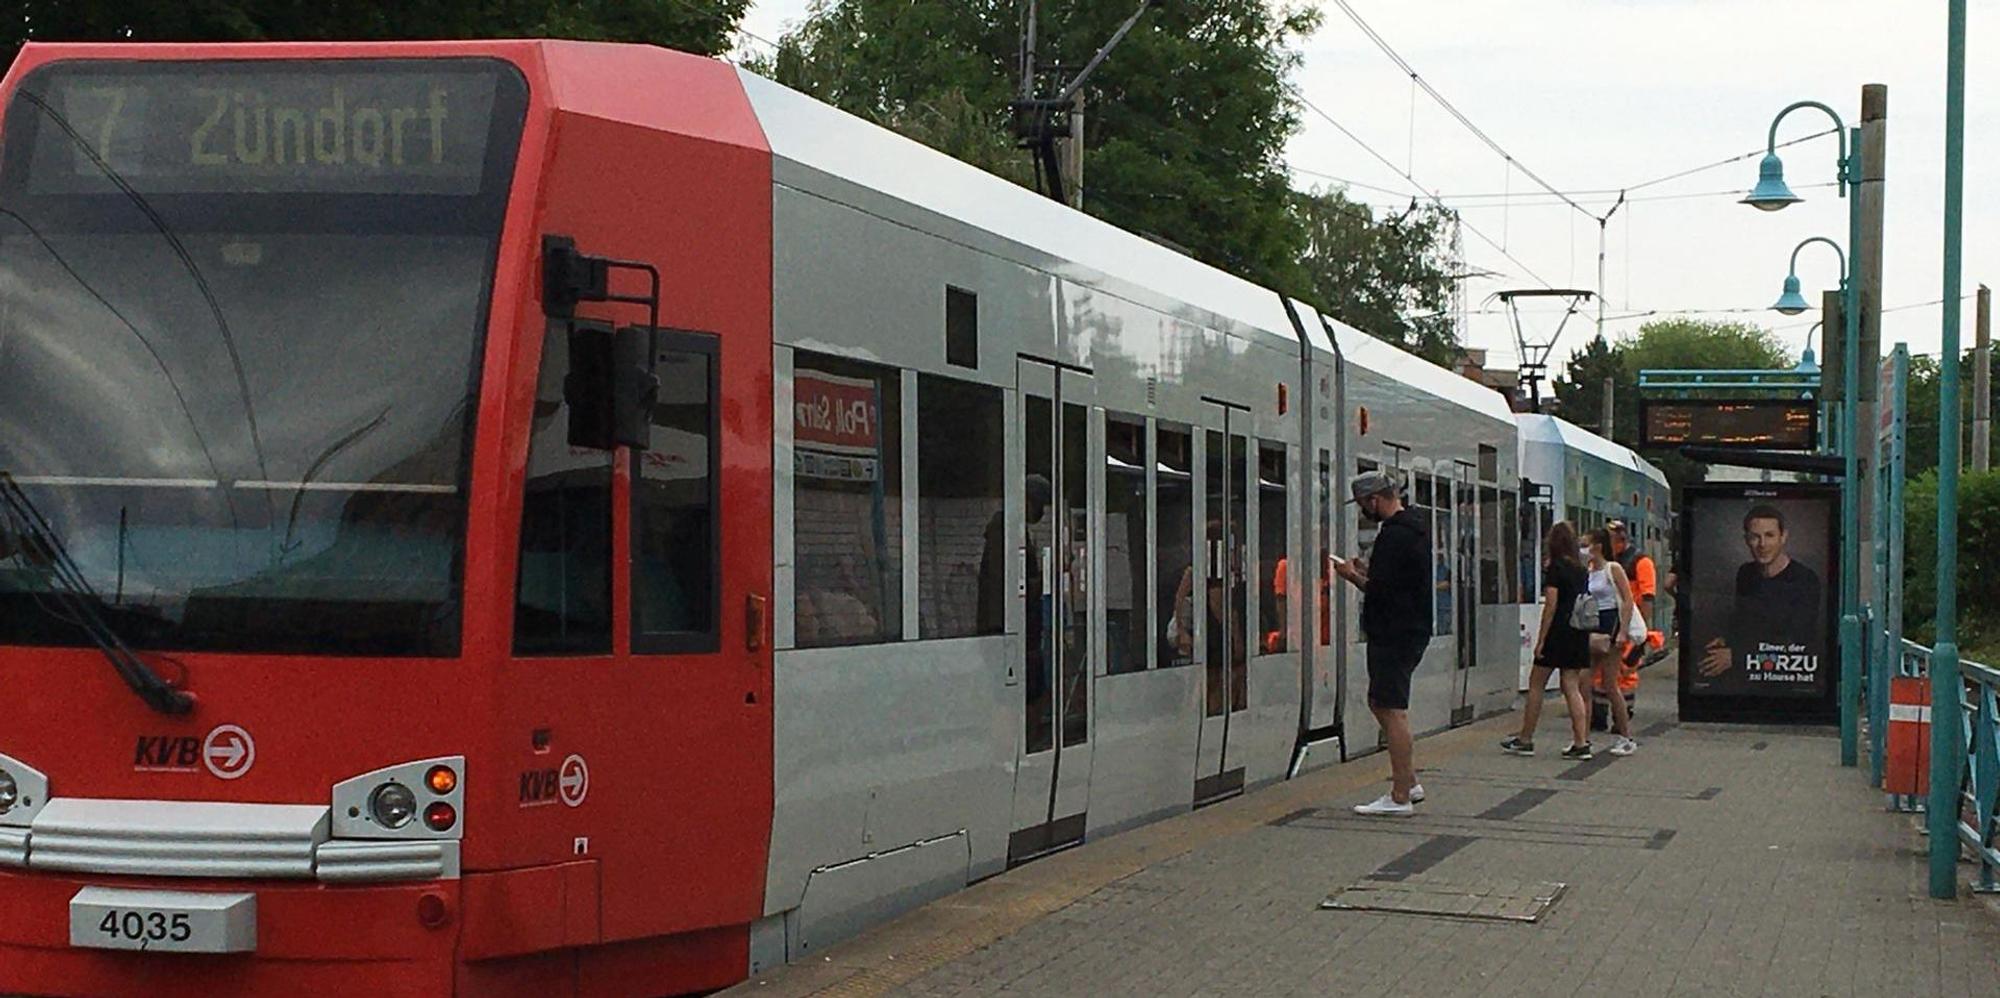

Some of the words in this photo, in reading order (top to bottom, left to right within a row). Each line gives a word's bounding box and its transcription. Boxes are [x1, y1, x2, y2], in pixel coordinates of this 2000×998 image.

[80, 86, 127, 166] 7
[189, 86, 449, 168] Zündorf
[1788, 643, 1806, 652] der
[1797, 673, 1814, 681] hat
[134, 736, 201, 766] KVB
[519, 770, 559, 802] KVB
[99, 910, 191, 941] 4035
